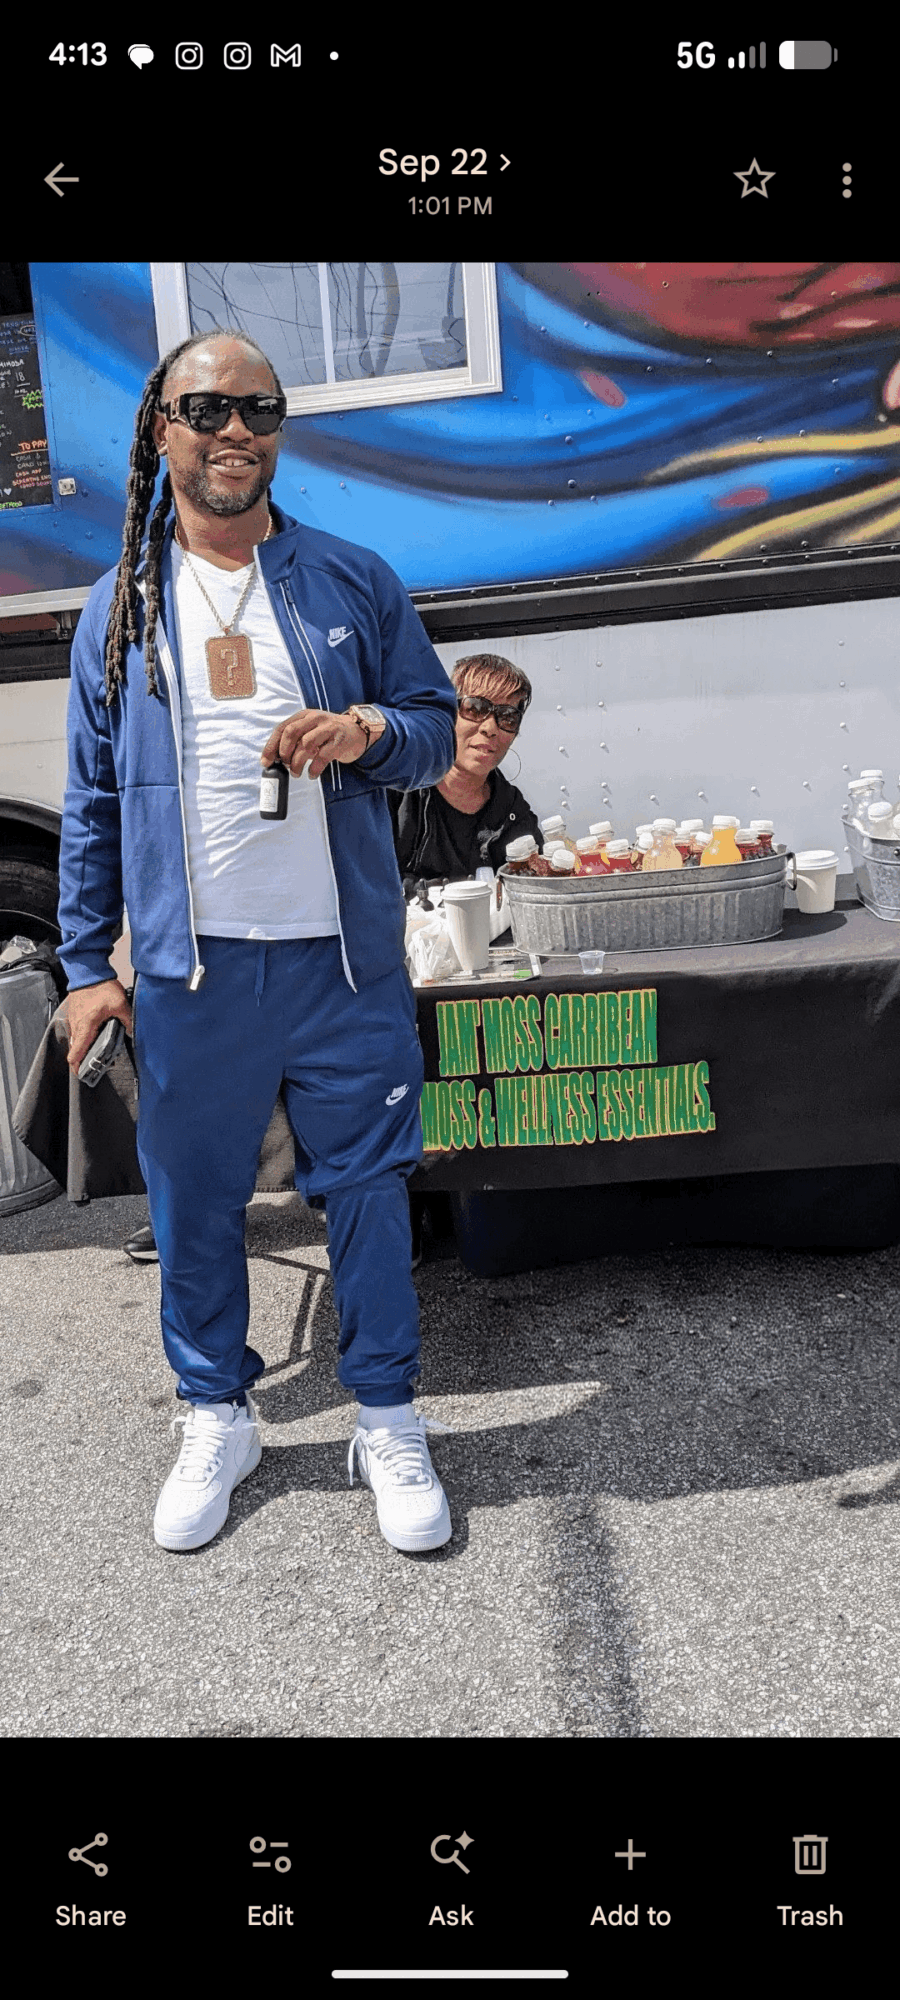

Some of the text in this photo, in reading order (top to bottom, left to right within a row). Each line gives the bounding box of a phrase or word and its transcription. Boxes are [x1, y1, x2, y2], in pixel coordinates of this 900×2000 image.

[18, 439, 47, 450] TO PAY
[329, 626, 347, 640] NIKE
[481, 994, 544, 1073] MOSS
[544, 988, 658, 1070] CARRIBEAN
[419, 1060, 716, 1151] MOSS & WELLNESS ESSENTIALS.
